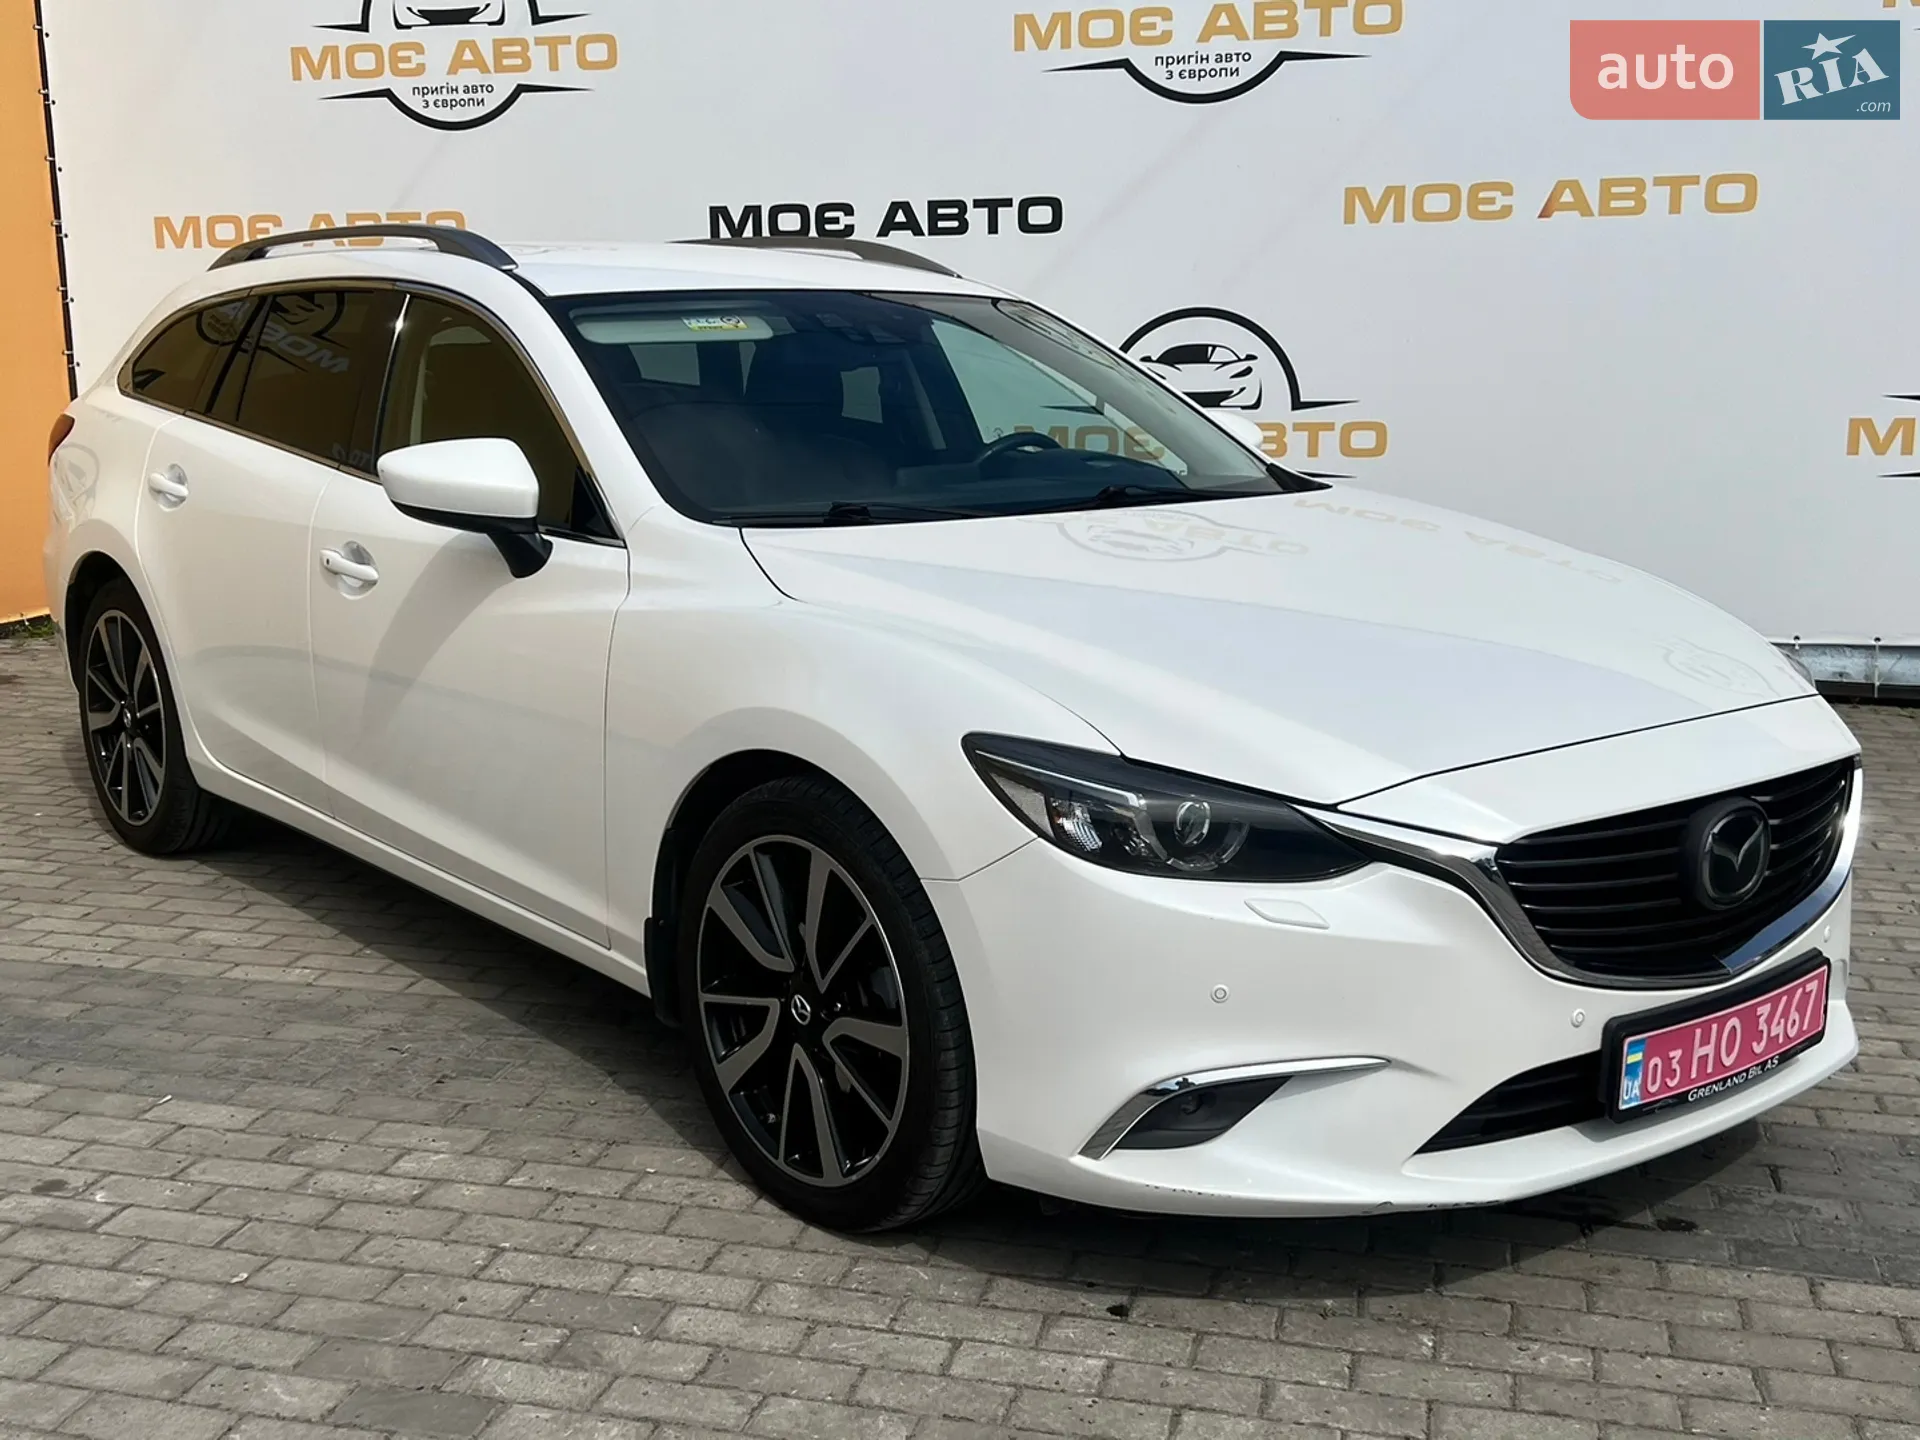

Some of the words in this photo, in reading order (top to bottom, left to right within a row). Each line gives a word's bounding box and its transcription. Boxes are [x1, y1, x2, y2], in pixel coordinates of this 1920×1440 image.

[1014, 6, 1173, 52] МОЄ
[1197, 0, 1404, 44] АВТО
[290, 41, 426, 81] МОЄ
[446, 33, 618, 75] АВТО
[1154, 50, 1209, 69] пригін
[1214, 52, 1252, 63] авто
[1165, 69, 1174, 80] з
[1178, 67, 1240, 82] європи
[412, 82, 459, 98] пригін
[462, 84, 495, 95] авто
[422, 98, 430, 109] з
[433, 97, 485, 110] європи
[709, 203, 855, 239] МОЄ
[876, 197, 1063, 237] АВТО
[1343, 181, 1514, 225] МОЄ
[1537, 173, 1759, 219] АВТО
[1646, 1048, 1682, 1093] 03
[1751, 979, 1819, 1055] 3467
[1623, 1075, 1640, 1101] UA
[1688, 1072, 1747, 1102] GRENLAND
[1764, 1055, 1780, 1071] AS
